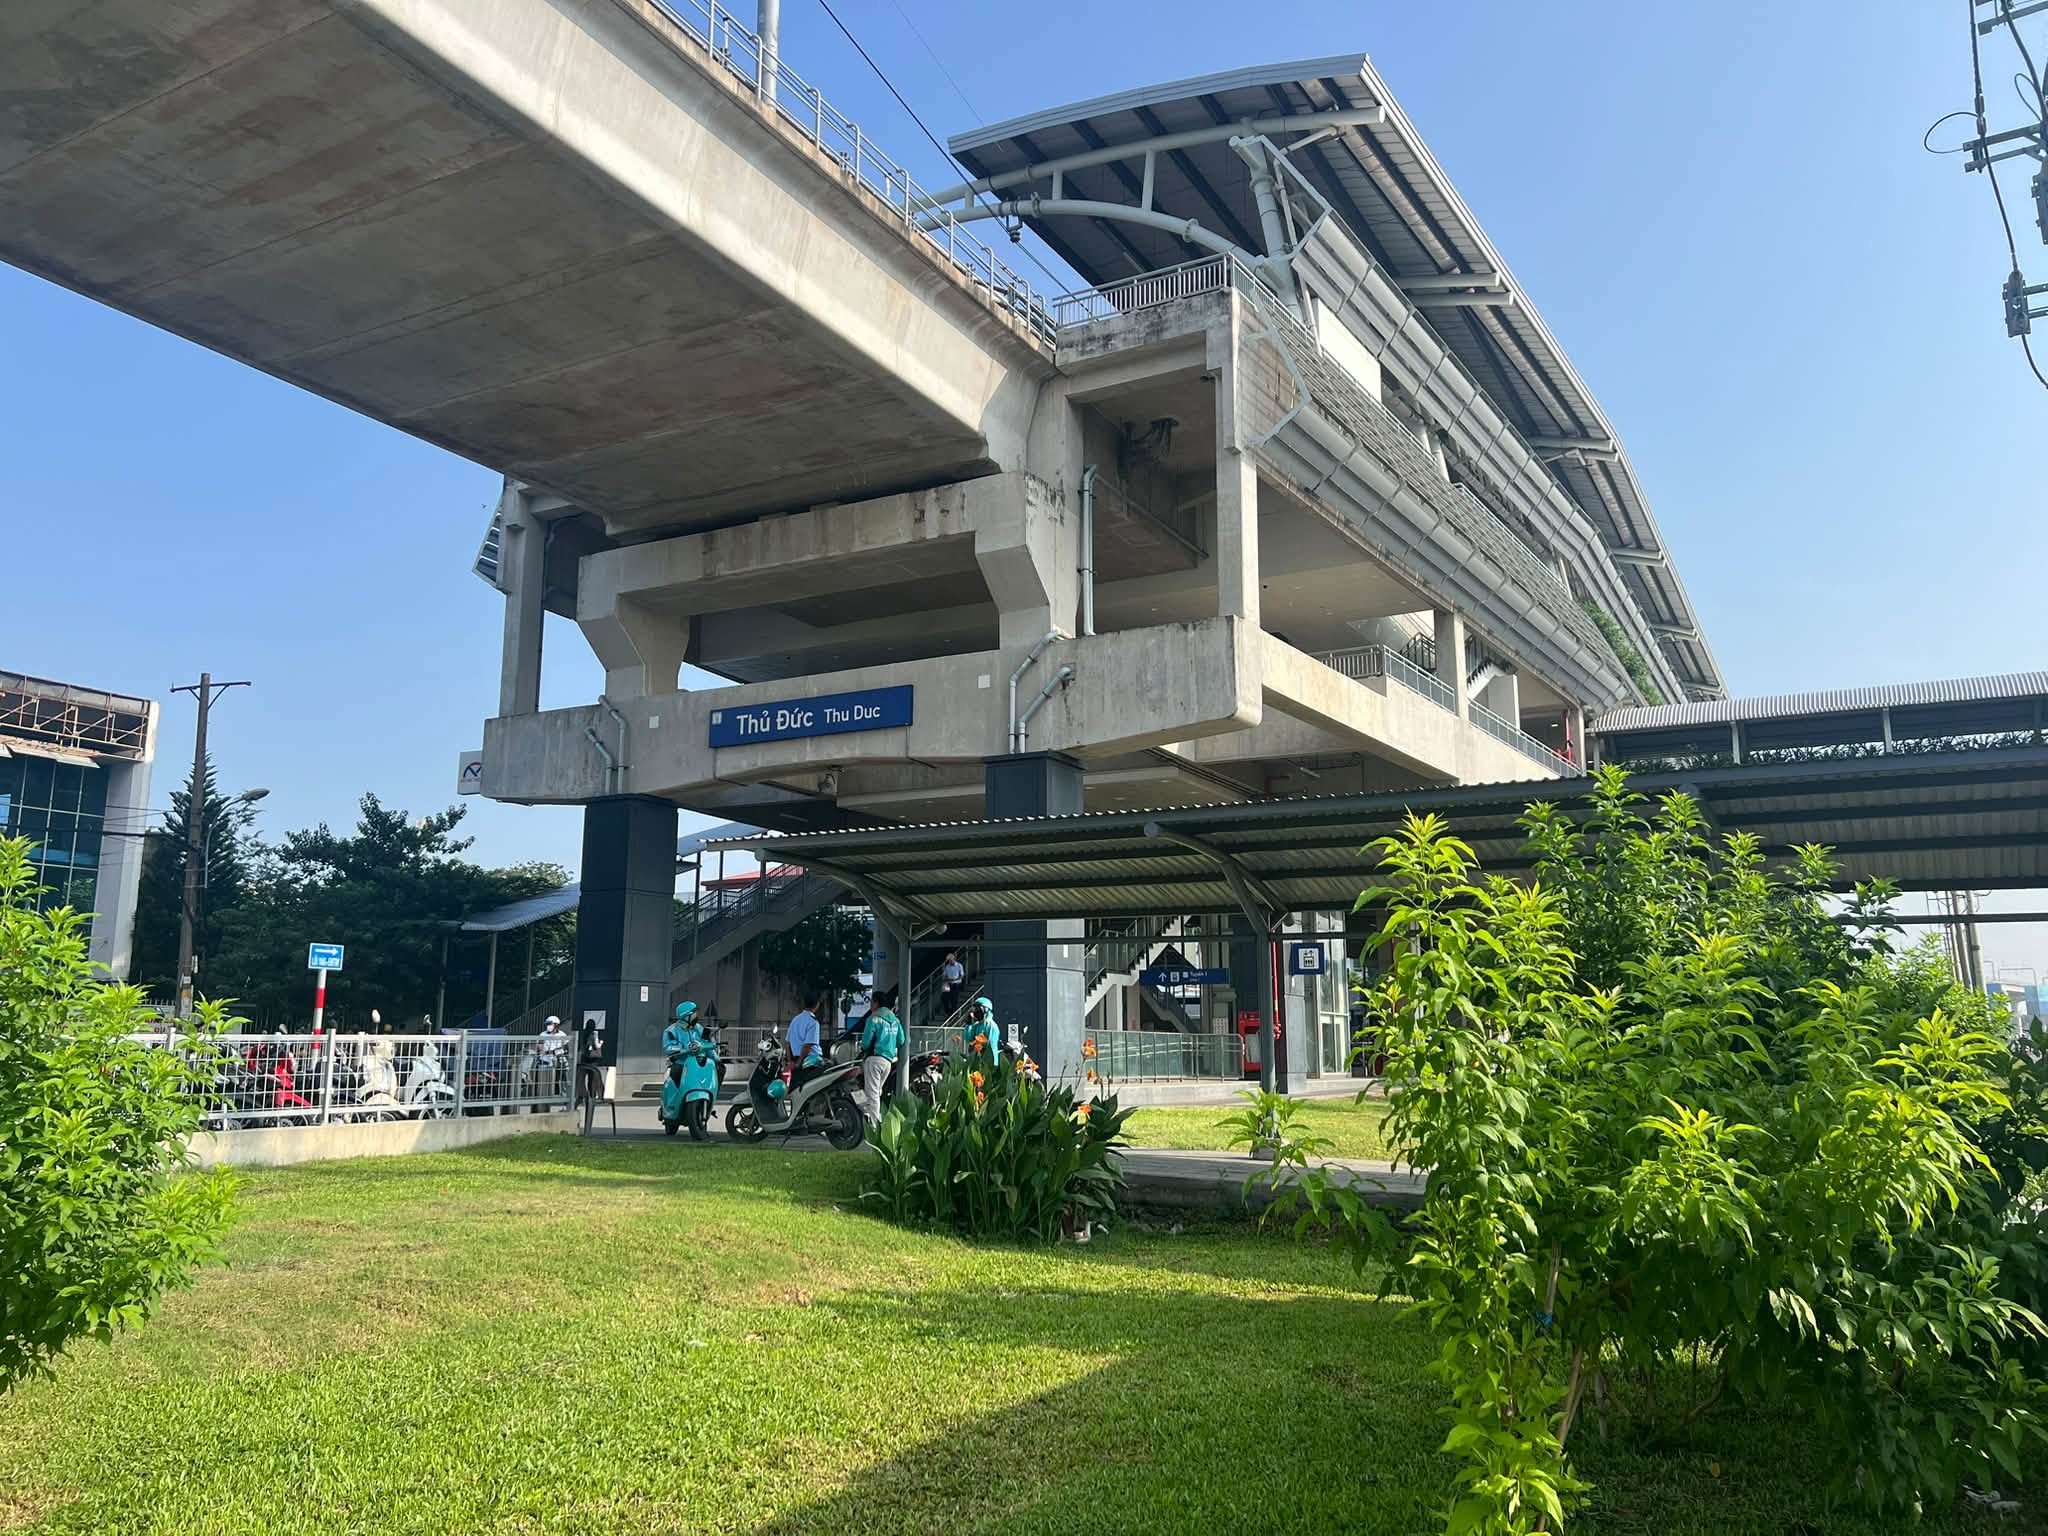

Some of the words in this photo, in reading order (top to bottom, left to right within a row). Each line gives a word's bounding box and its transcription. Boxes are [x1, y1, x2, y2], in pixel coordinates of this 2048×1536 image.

[736, 710, 770, 735] Thủ
[776, 707, 814, 730] Đức
[824, 707, 849, 724] Thu
[854, 704, 881, 720] Duc
